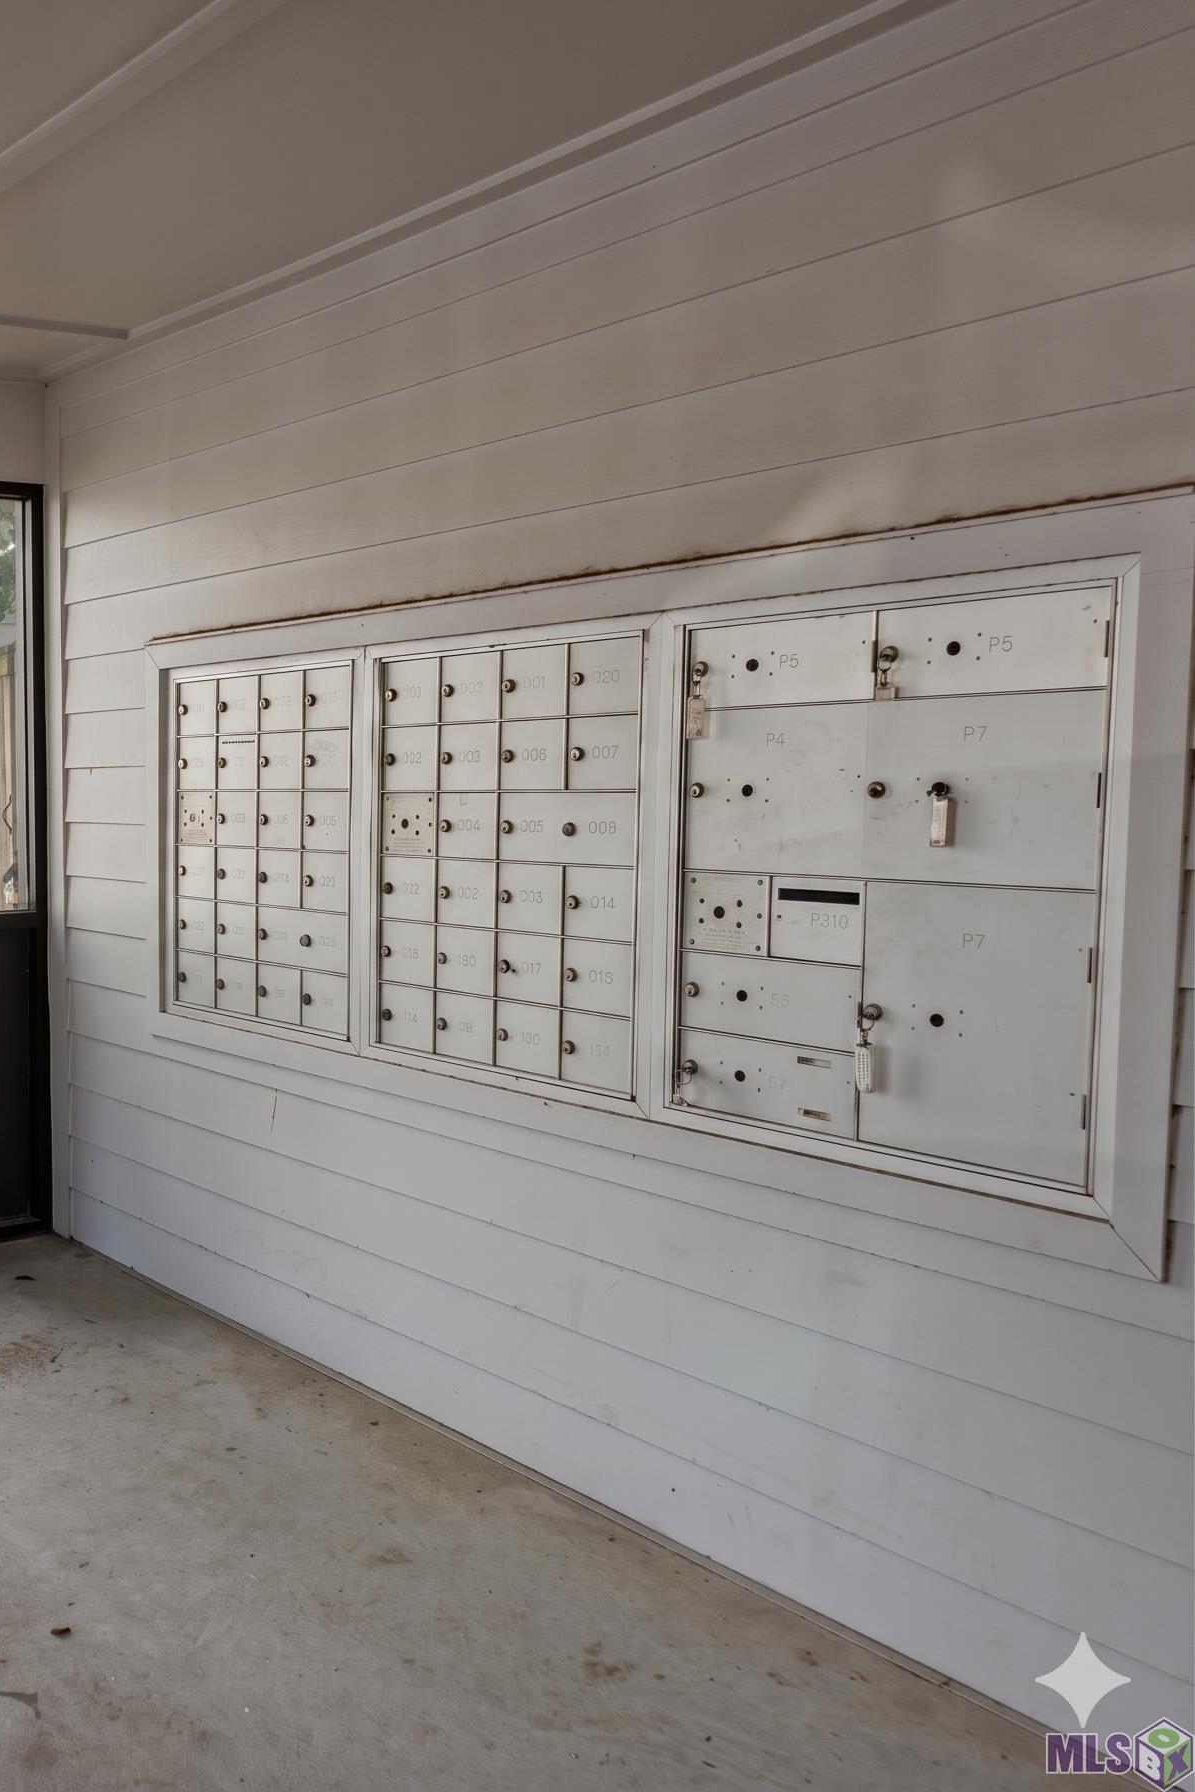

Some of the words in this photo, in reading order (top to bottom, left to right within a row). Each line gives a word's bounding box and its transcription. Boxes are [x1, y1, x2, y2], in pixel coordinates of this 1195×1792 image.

[988, 636, 1013, 654] P5
[779, 653, 800, 669] P5
[765, 732, 785, 747] P4
[963, 726, 988, 742] P7
[592, 745, 618, 760] 007
[520, 819, 544, 833] 005
[590, 895, 615, 909] 014
[810, 913, 849, 930] P310
[962, 933, 986, 950] P7
[521, 961, 542, 975] 017
[768, 1075, 787, 1091] 57
